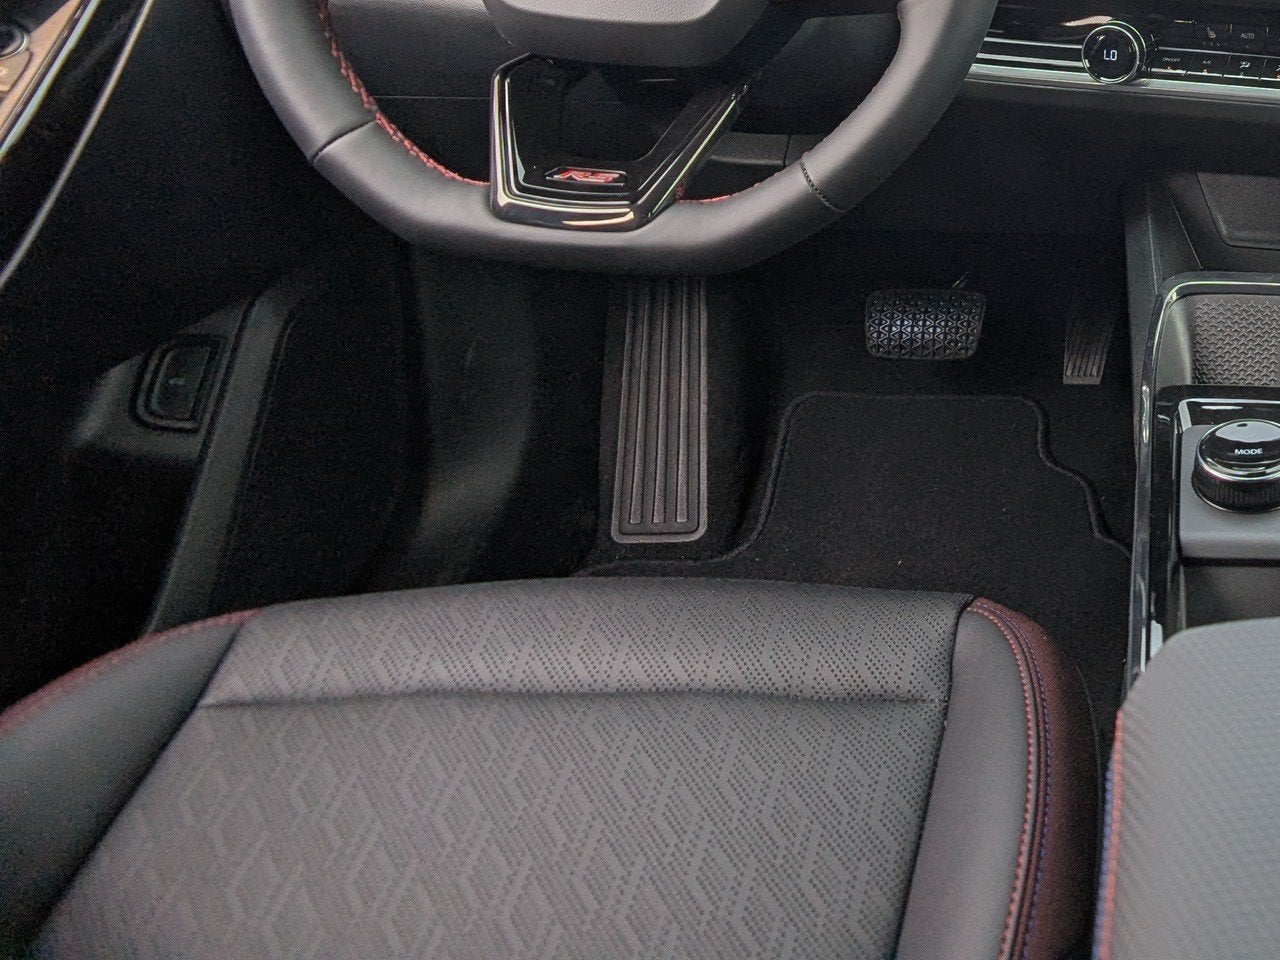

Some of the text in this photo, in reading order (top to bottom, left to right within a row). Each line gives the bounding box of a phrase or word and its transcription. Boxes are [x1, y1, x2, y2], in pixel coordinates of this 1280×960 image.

[1240, 32, 1255, 40] AUTO
[553, 167, 620, 183] RS
[1234, 447, 1263, 455] MODE
